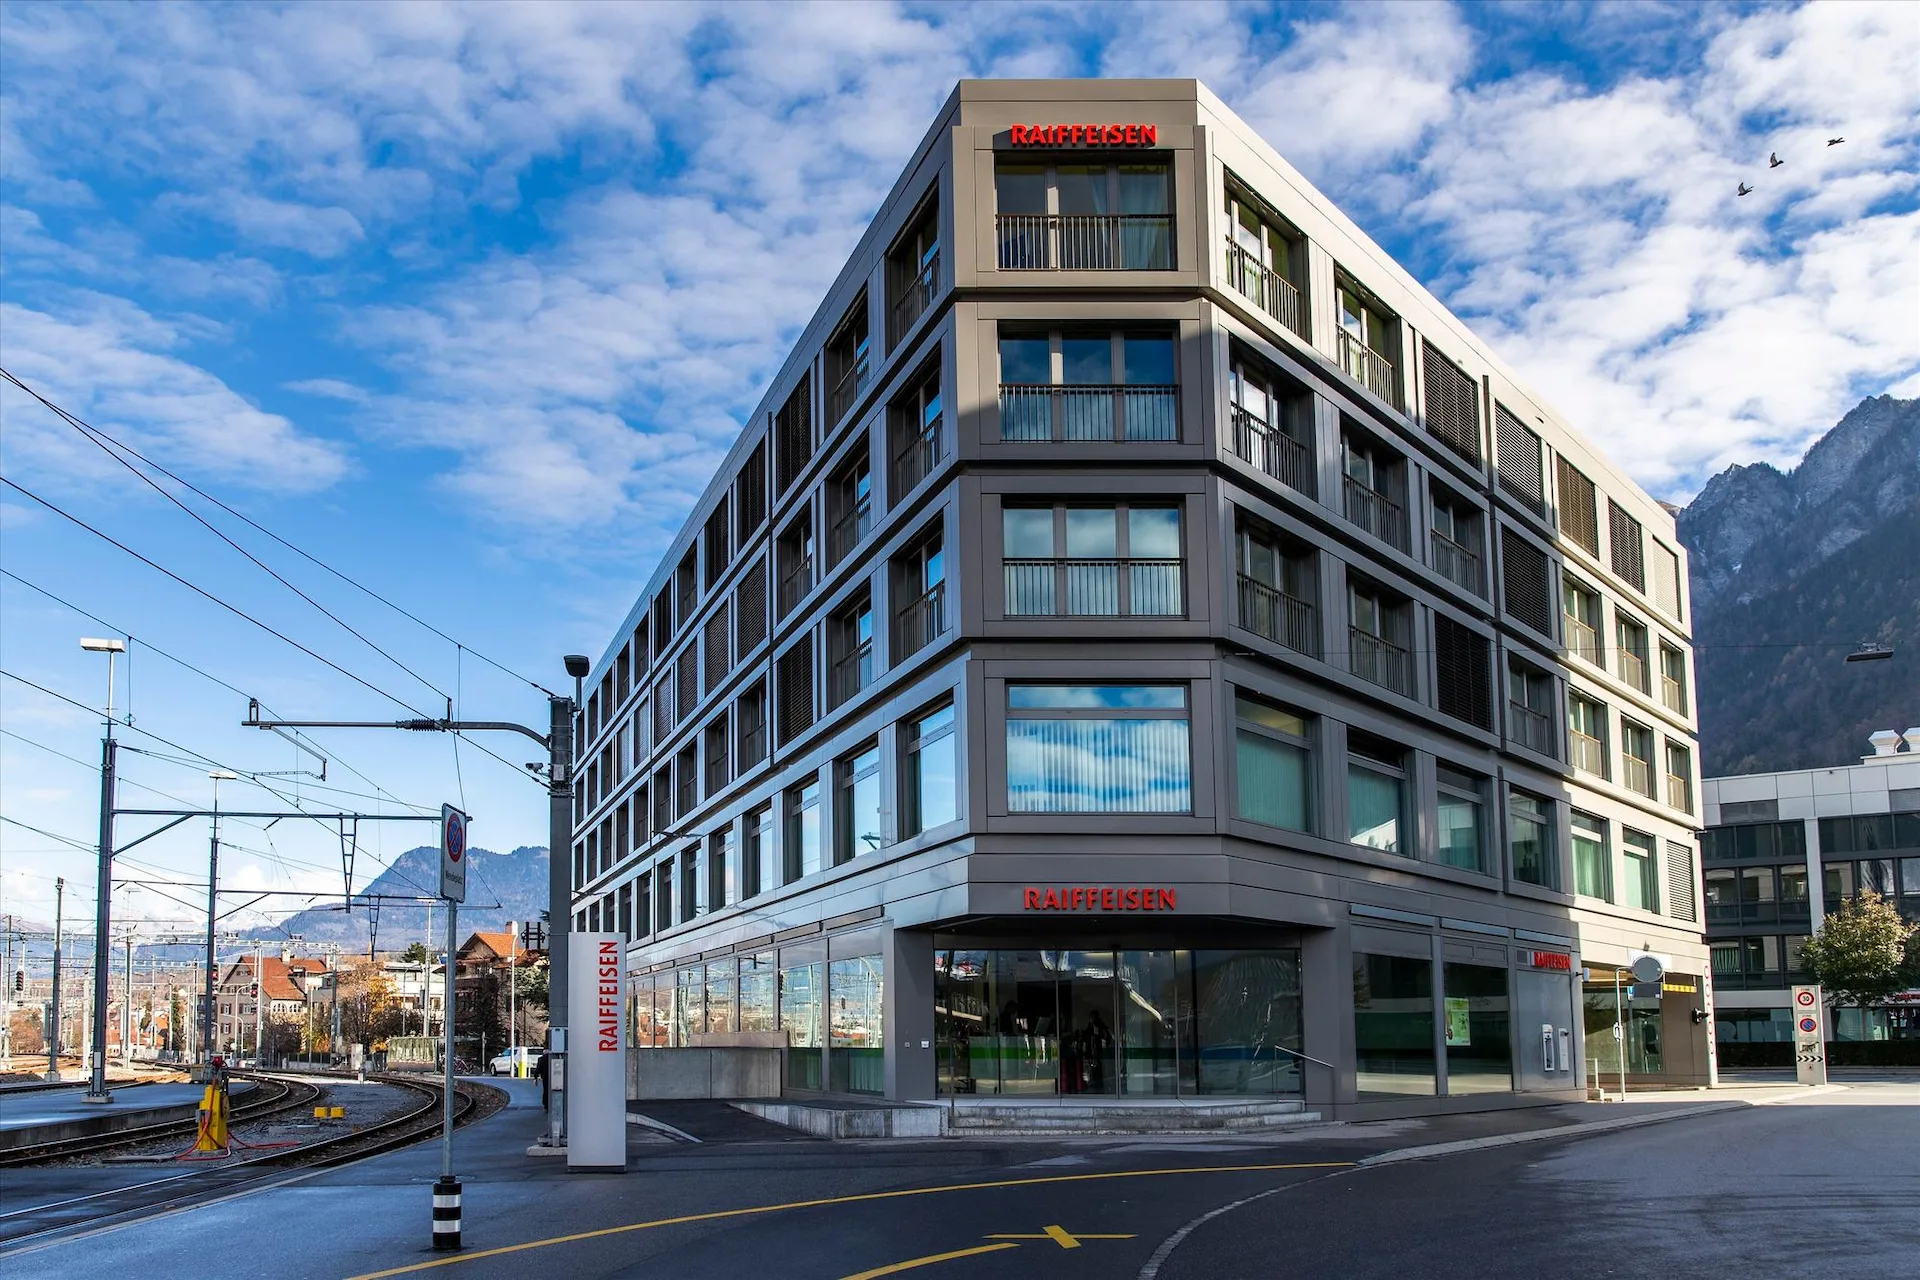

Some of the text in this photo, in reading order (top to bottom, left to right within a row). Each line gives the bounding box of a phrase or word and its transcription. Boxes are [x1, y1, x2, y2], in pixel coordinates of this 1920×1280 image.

[1011, 123, 1158, 146] RAIFFEISEN
[1024, 886, 1177, 910] RAIFFEISEN
[599, 941, 618, 1052] RAIFFEISEN
